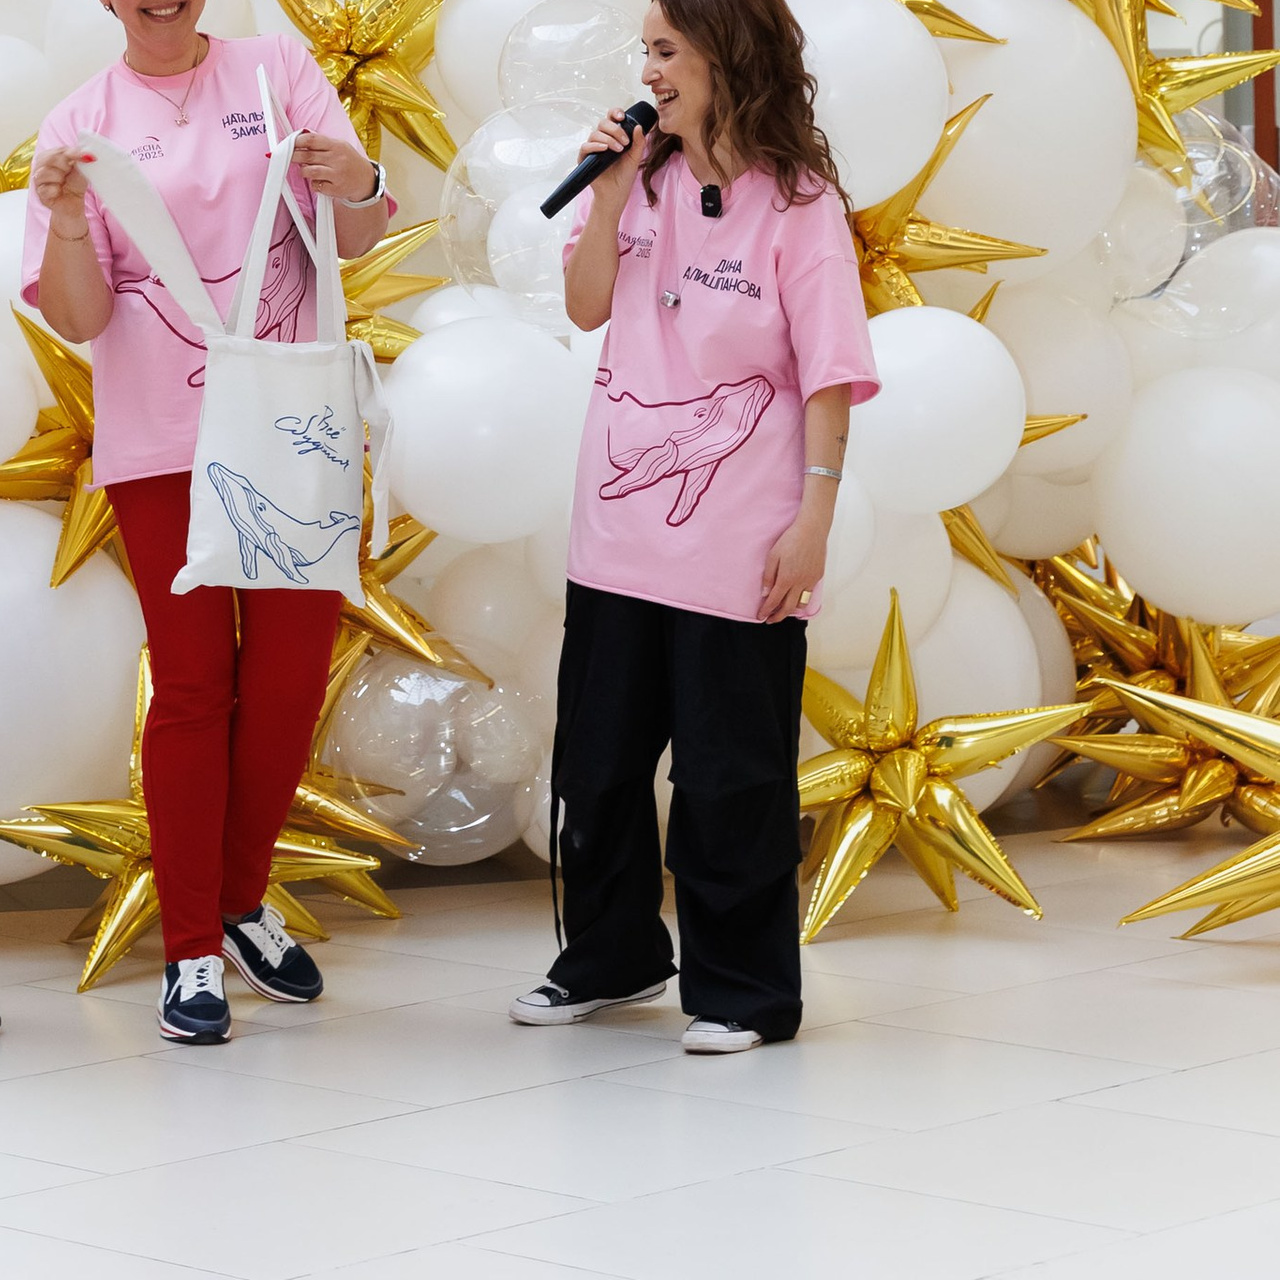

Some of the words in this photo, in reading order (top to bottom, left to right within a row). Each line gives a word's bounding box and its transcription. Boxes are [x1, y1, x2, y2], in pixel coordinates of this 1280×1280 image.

[222, 110, 265, 128] НАТАЛЬ
[138, 150, 165, 162] 2025
[617, 231, 636, 244] НАЯ
[713, 258, 743, 275] ДИНА
